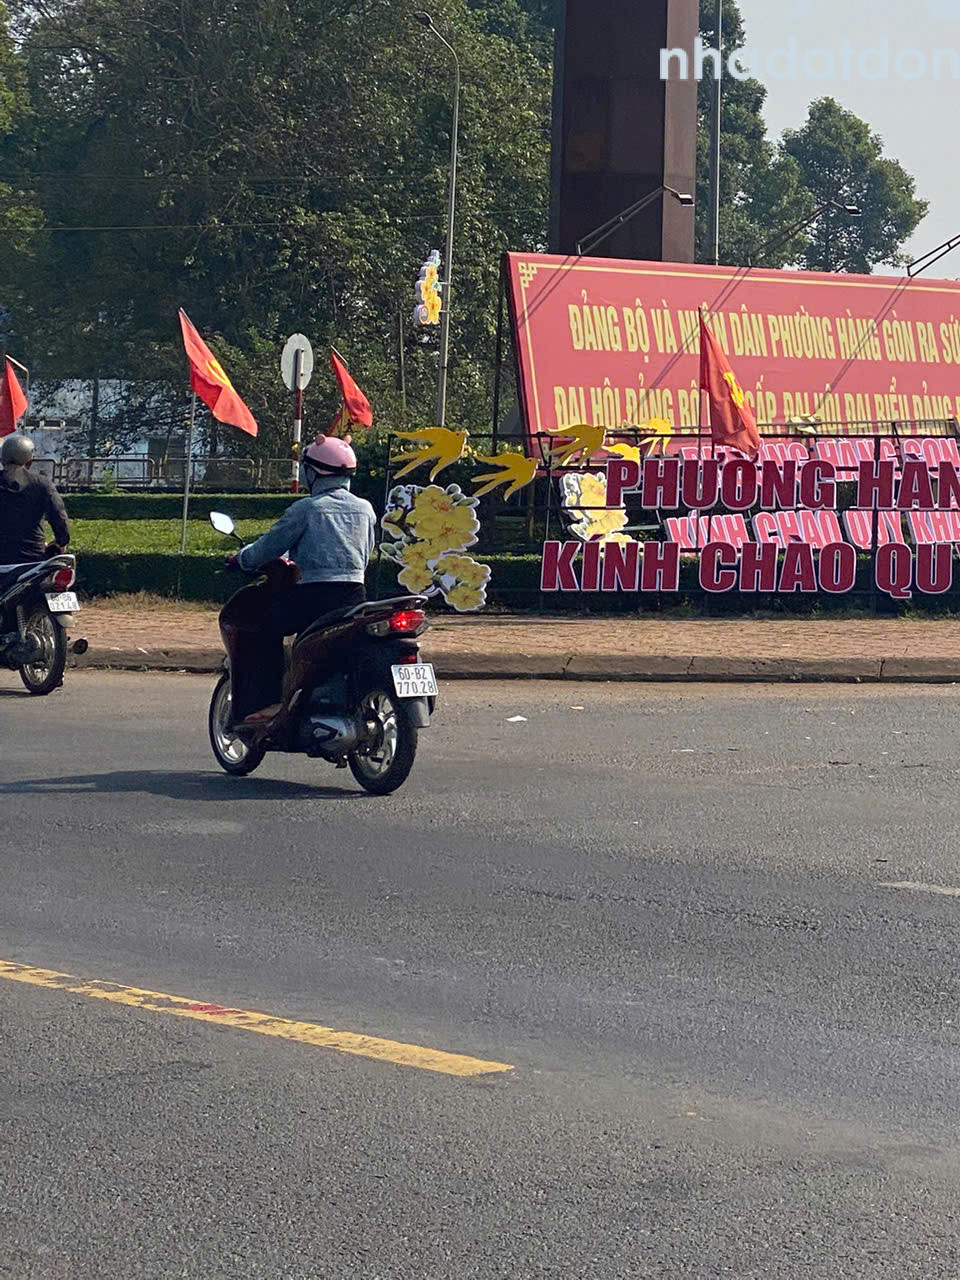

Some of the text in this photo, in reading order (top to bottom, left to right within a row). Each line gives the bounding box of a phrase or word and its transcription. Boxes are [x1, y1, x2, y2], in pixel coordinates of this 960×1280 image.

[567, 289, 622, 352] ĐẢNG
[622, 297, 650, 363] BỘ
[650, 298, 678, 354] VÀ
[728, 304, 768, 358] DÂN
[767, 305, 836, 360] PHƯỜNG
[835, 308, 882, 361] HÀNG
[881, 310, 917, 363] GÒN
[915, 321, 940, 364] RA
[605, 451, 837, 510] PHƯỜNG
[540, 533, 680, 592] KÍNH
[698, 534, 857, 593] CHÀO
